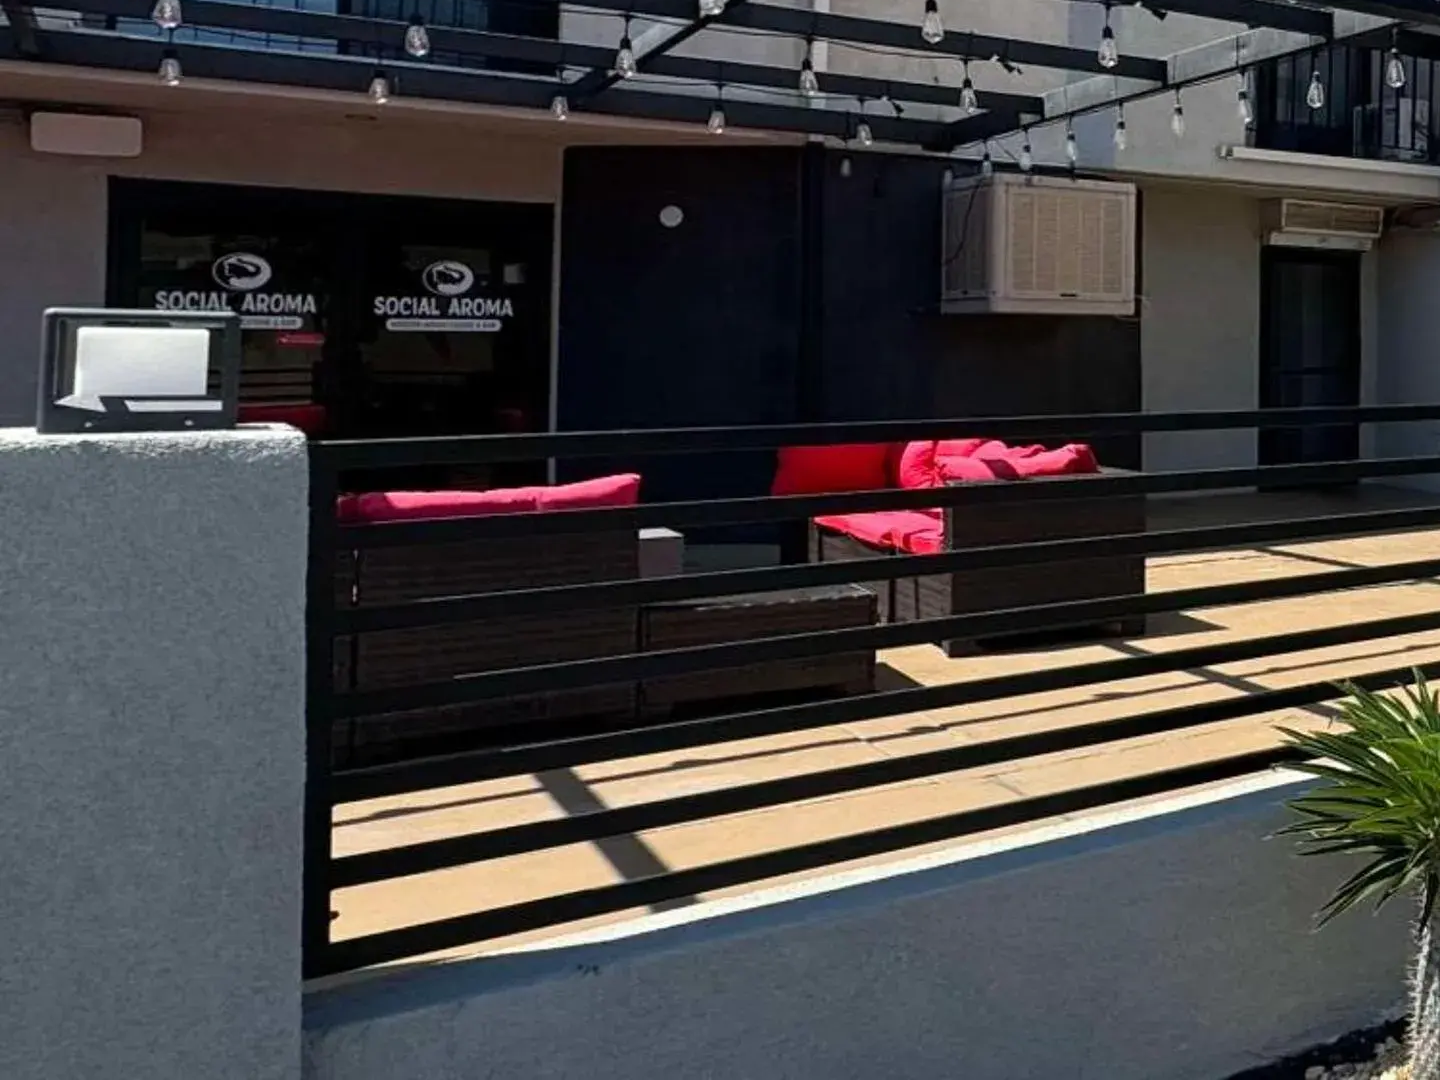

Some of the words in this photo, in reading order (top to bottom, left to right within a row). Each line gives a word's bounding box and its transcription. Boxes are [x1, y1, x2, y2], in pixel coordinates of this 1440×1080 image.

[154, 290, 232, 312] SOCIAL
[240, 292, 317, 314] AROMA
[373, 295, 441, 316] SOCIAL
[447, 297, 515, 318] AROMA
